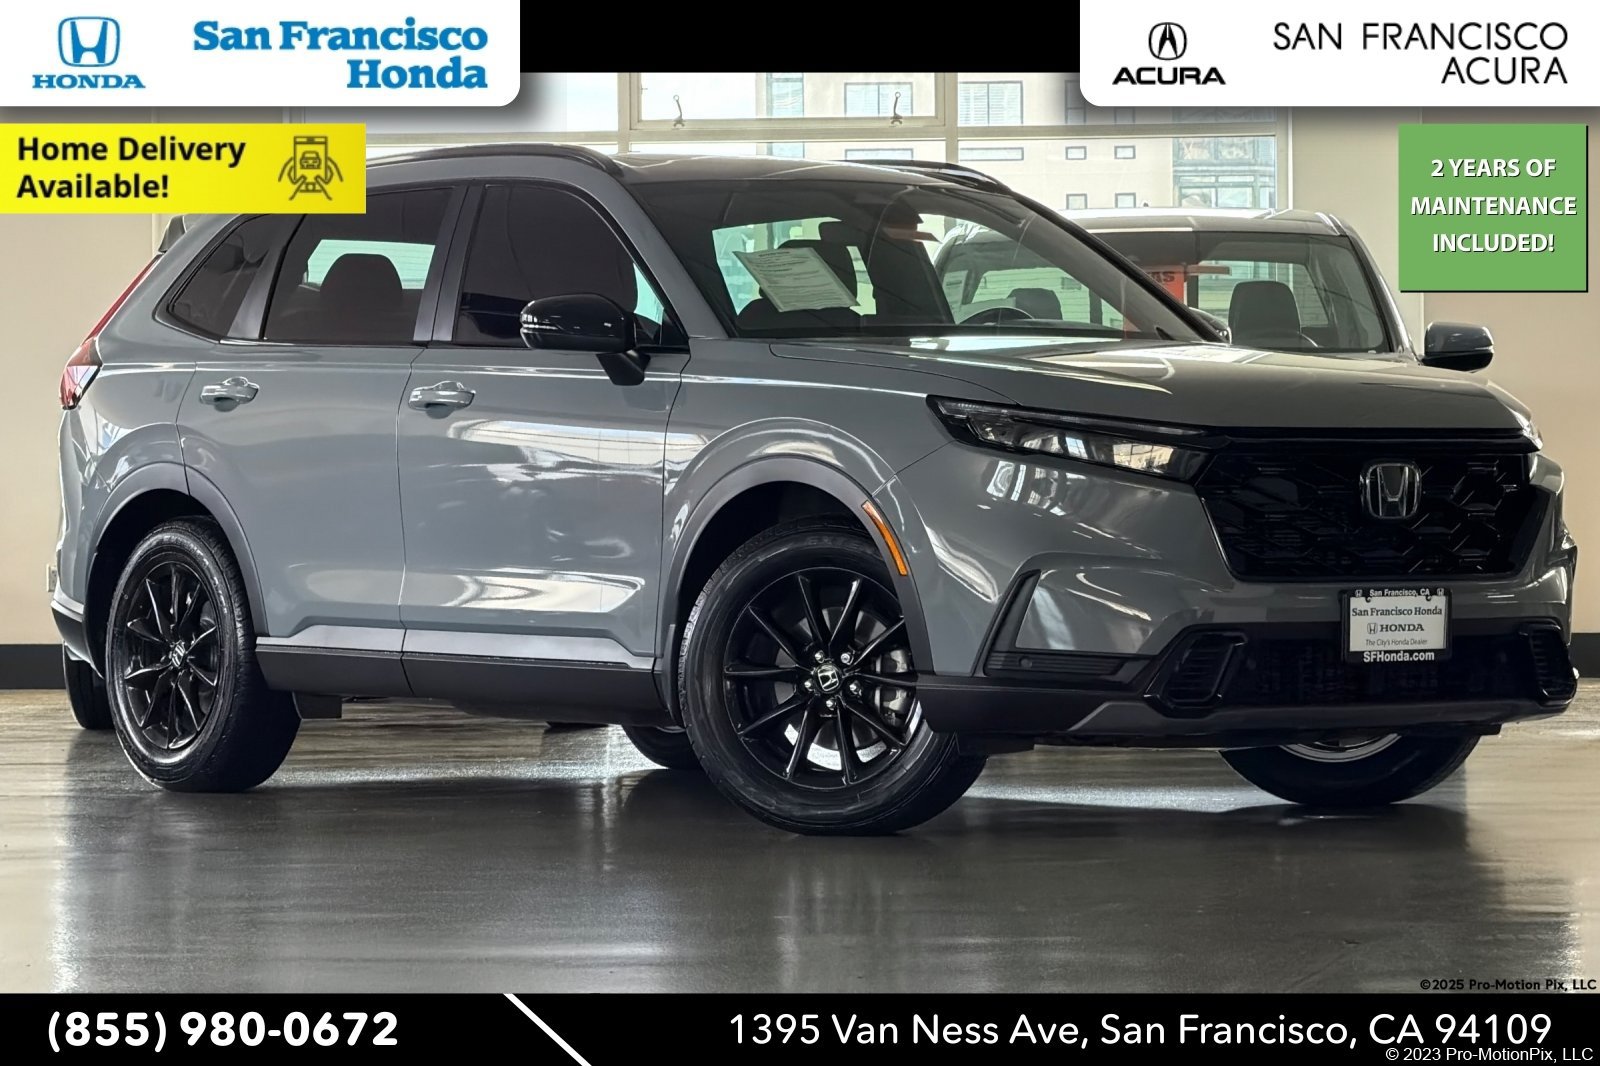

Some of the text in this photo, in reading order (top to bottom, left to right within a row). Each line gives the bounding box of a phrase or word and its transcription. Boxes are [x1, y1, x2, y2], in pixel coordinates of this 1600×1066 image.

[1369, 588, 1430, 598] San Francisco, CA
[1352, 605, 1443, 617] San Francisco Honda
[1379, 623, 1425, 633] HONDA
[1376, 639, 1390, 647] City's
[1410, 638, 1428, 646] Dealer
[1363, 650, 1435, 662] SFHonda.com
